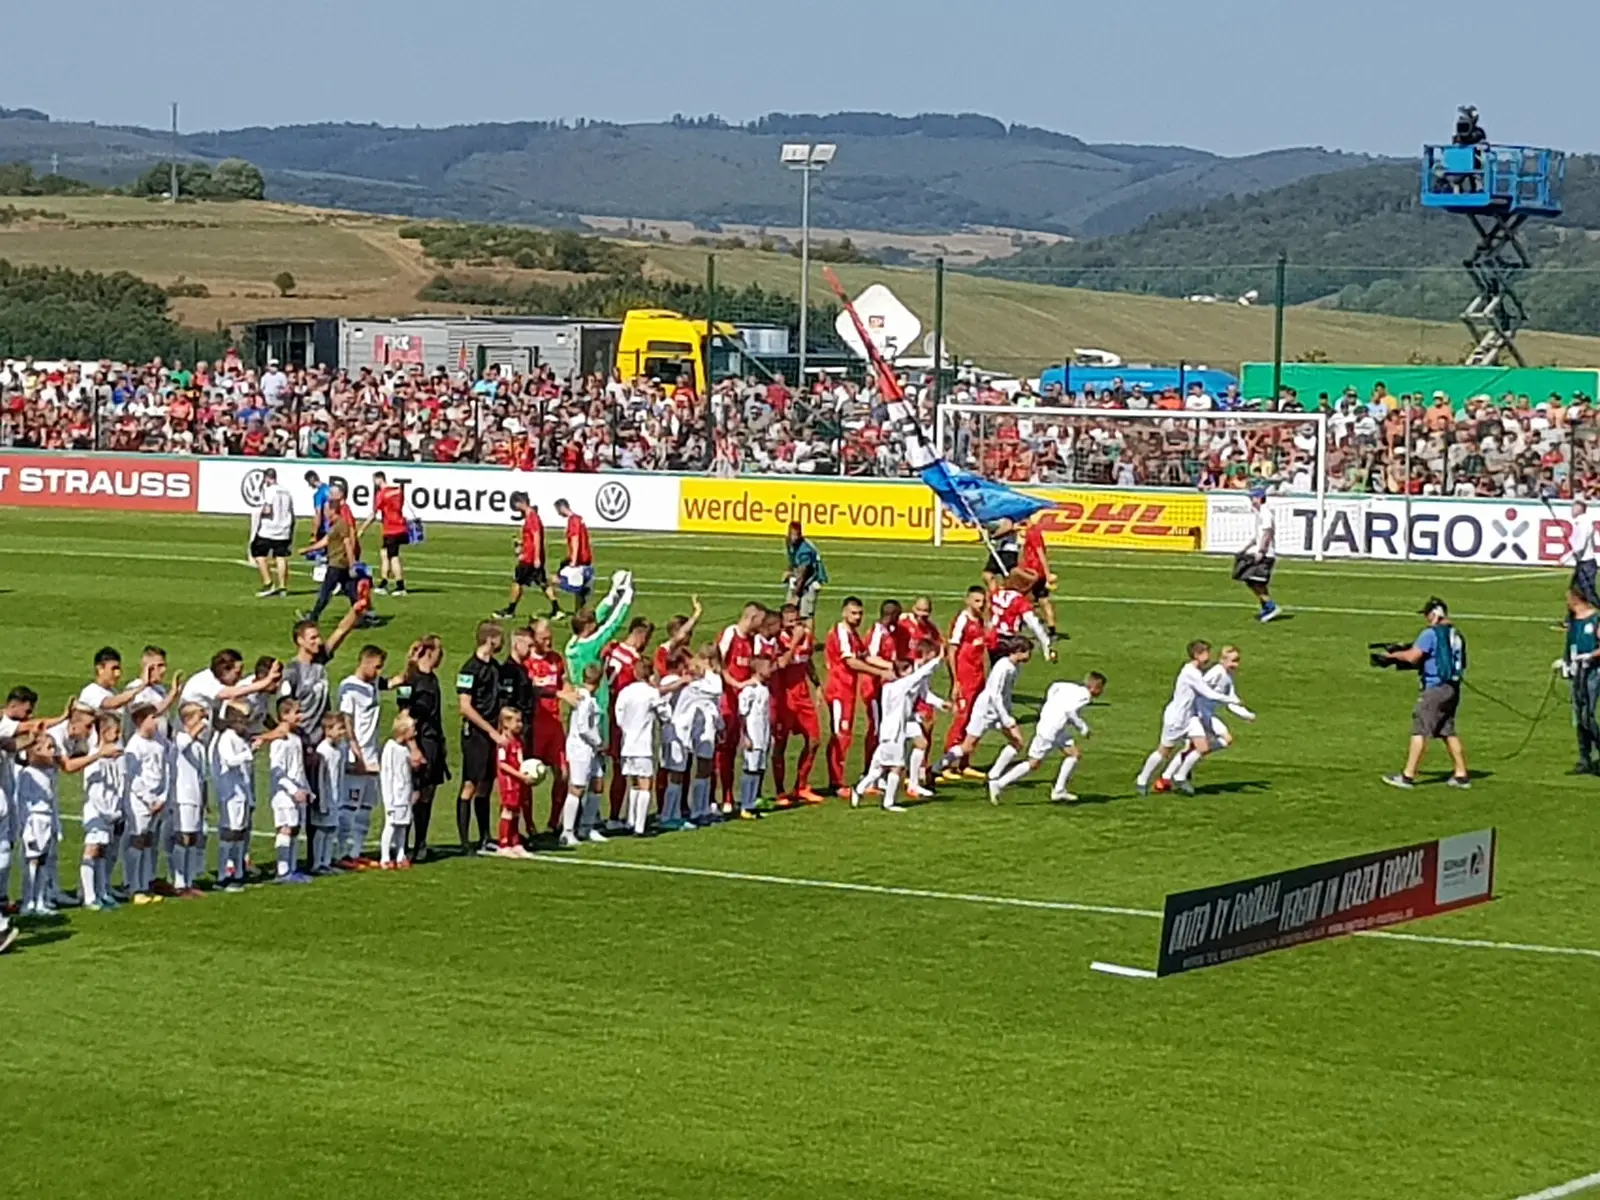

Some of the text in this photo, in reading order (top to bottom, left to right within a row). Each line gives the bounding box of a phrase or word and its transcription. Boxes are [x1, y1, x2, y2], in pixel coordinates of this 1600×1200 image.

[18, 466, 192, 498] STRAUSS
[1038, 502, 1173, 535] DHL
[1293, 508, 1483, 558] TARGO
